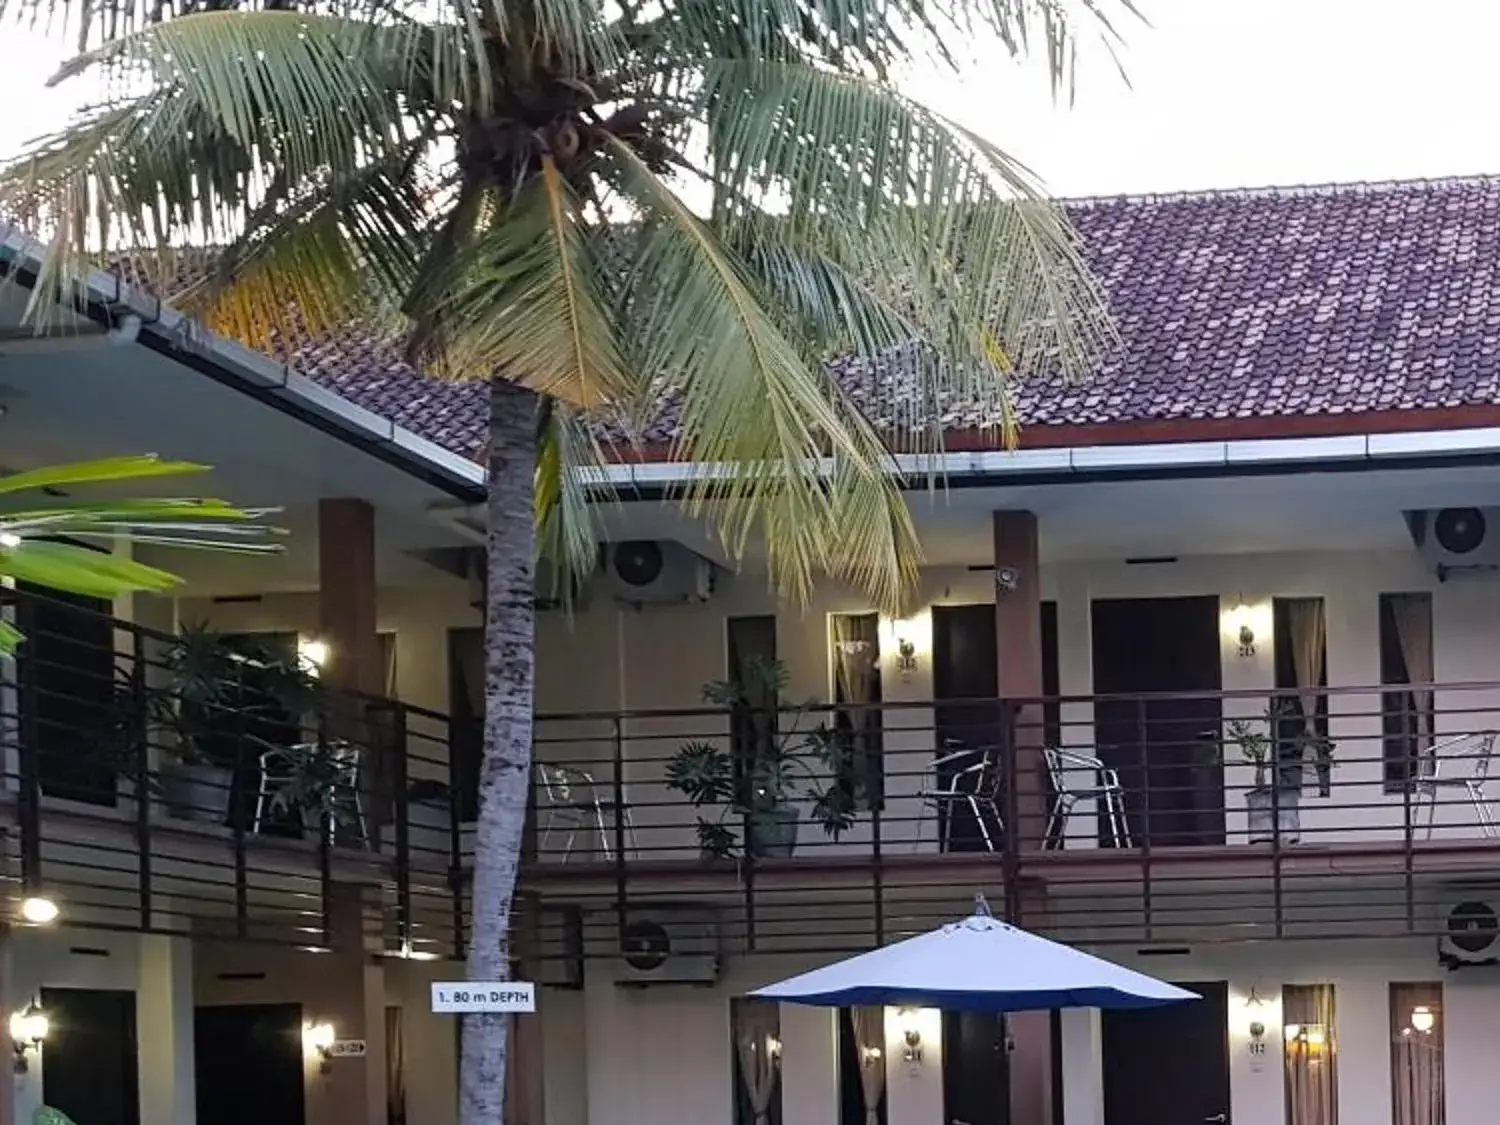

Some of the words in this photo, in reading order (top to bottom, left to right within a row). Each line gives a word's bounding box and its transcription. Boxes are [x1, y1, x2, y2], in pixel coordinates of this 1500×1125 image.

[454, 991, 469, 1003] 80
[473, 993, 487, 1003] m
[490, 991, 528, 1003] DEPTH
